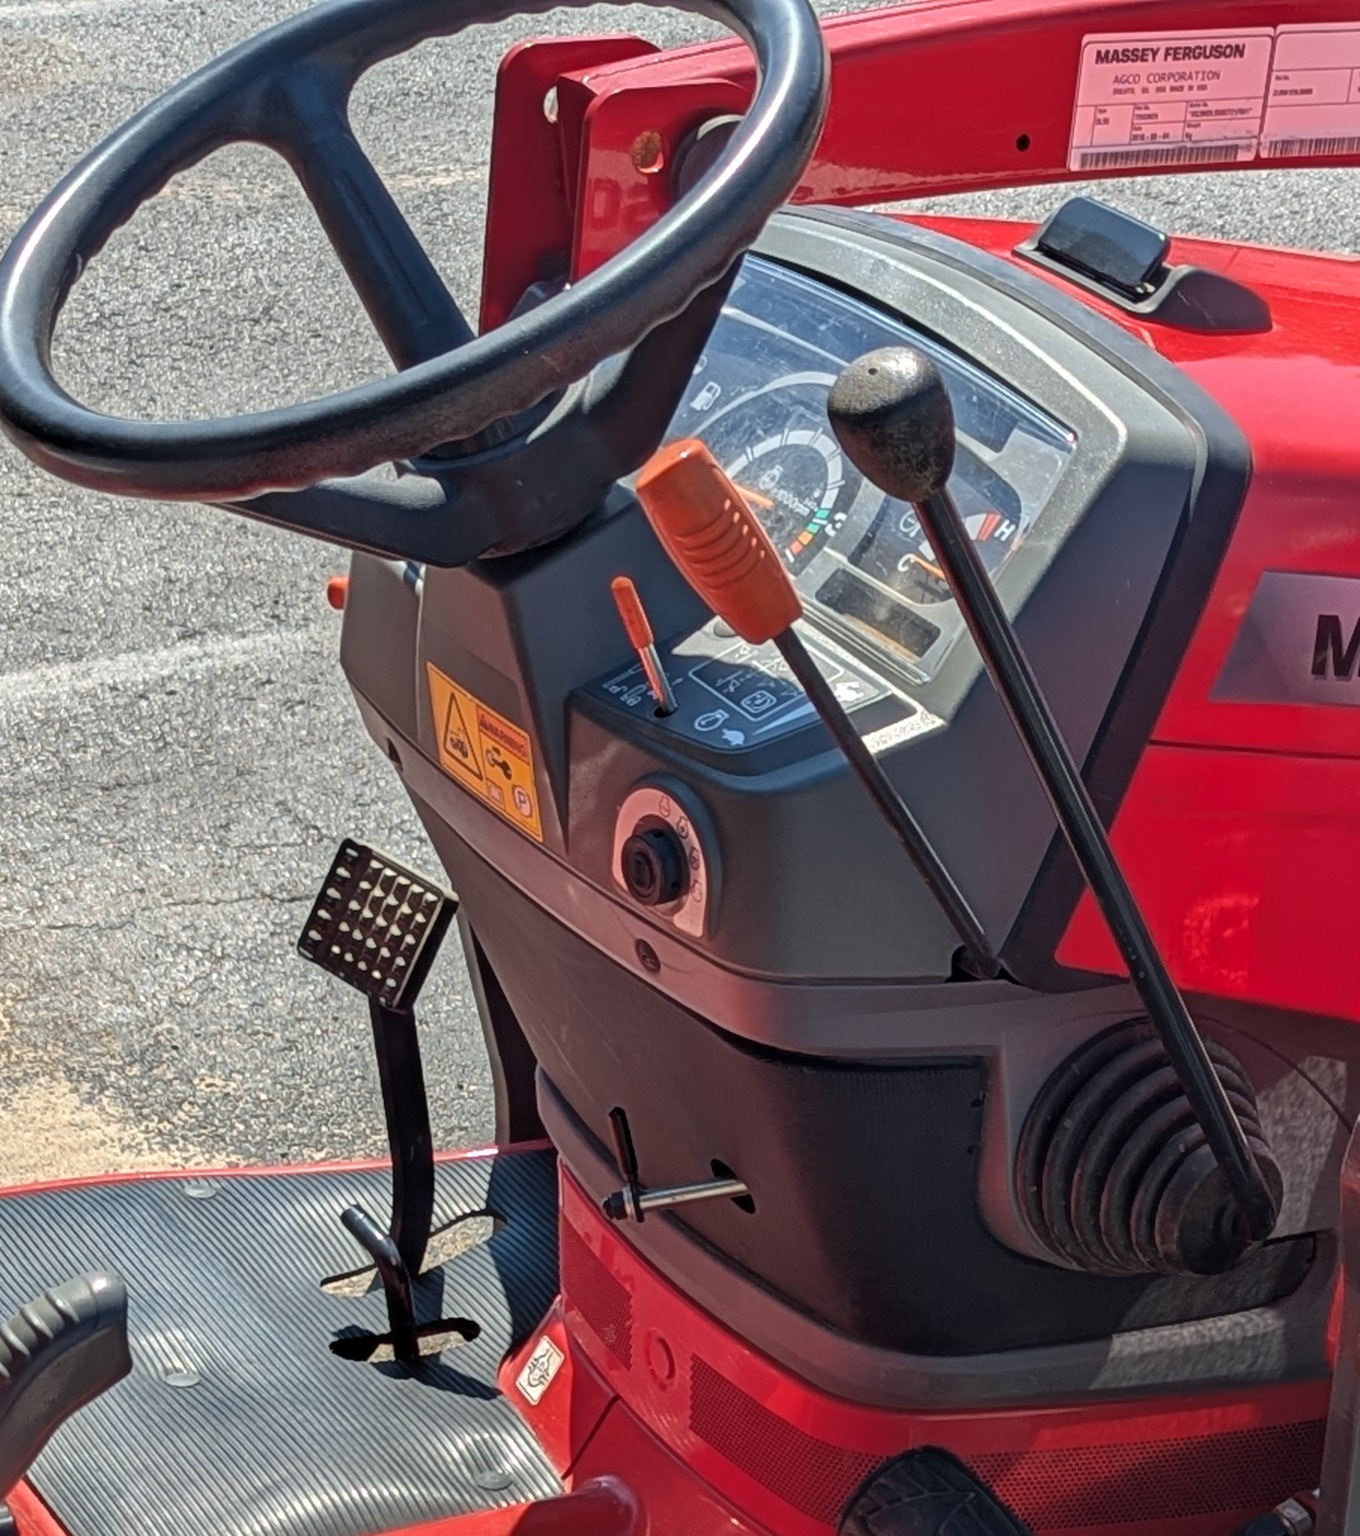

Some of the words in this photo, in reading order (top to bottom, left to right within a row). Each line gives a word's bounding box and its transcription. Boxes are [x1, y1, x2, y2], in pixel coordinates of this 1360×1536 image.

[1094, 47, 1160, 65] MASSEY
[1163, 43, 1246, 62] FERGUSON
[1112, 73, 1141, 85] AGCO
[1146, 70, 1222, 84] CORPORATION
[993, 519, 1016, 541] H
